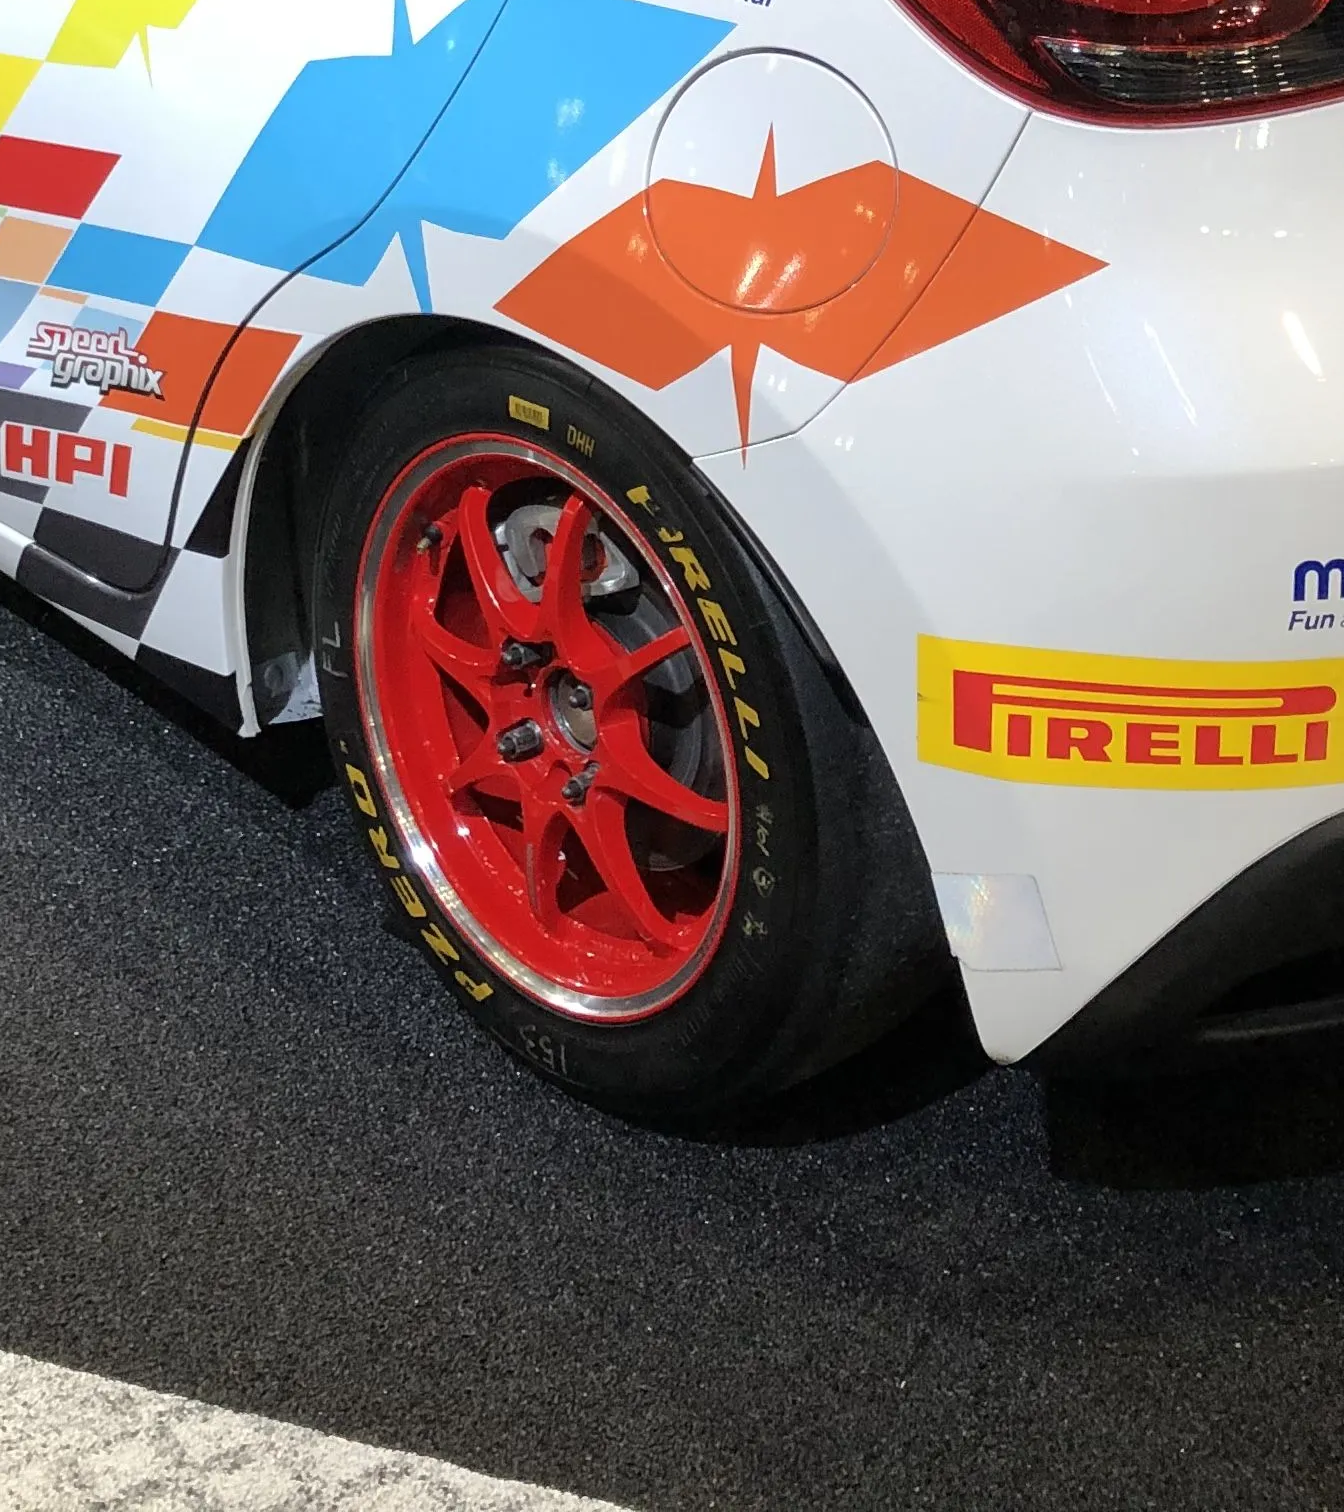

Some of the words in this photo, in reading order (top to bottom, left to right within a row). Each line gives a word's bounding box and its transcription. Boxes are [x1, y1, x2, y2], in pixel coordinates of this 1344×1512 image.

[4, 423, 133, 498] HPI
[1288, 609, 1335, 632] Fun
[953, 669, 1338, 766] PIRELLI
